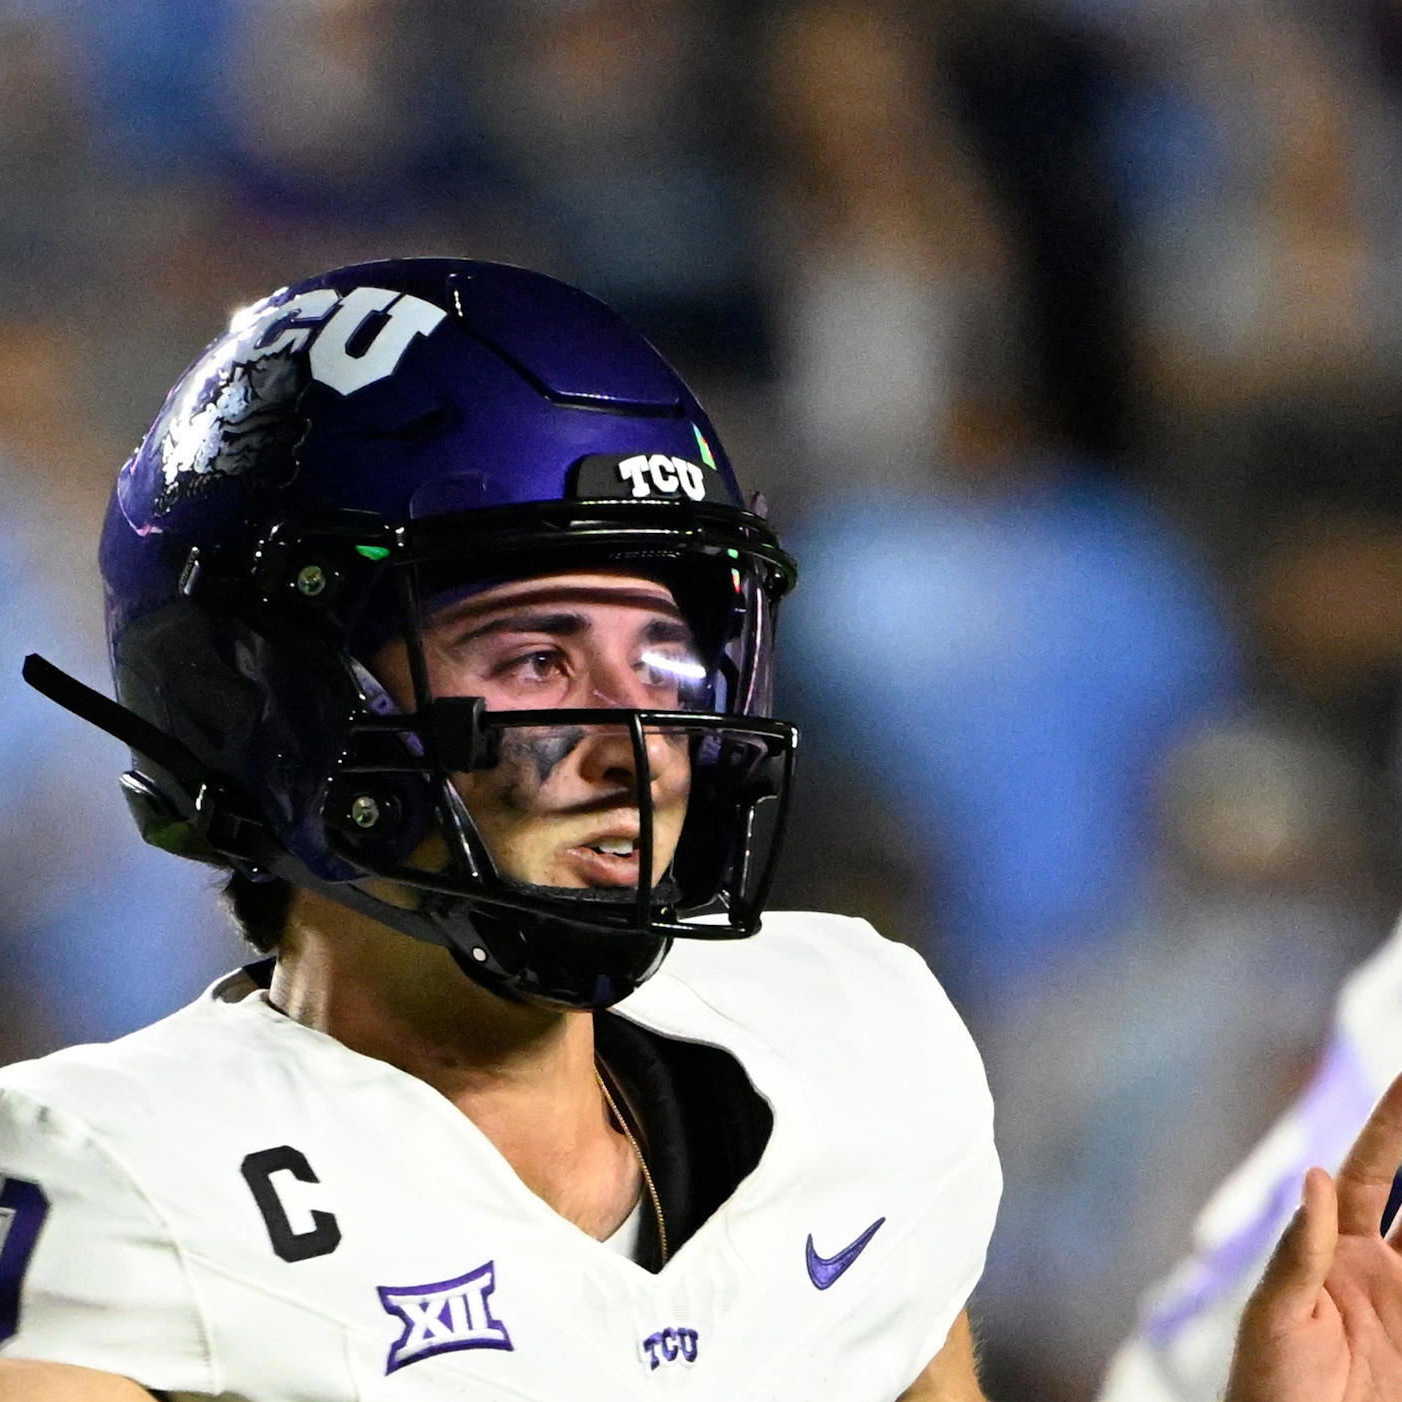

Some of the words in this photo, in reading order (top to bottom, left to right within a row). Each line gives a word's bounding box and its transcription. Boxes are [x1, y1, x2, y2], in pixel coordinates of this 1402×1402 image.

[618, 454, 706, 502] TCU
[240, 1145, 343, 1263] C
[382, 1266, 509, 1366] XII
[643, 1327, 699, 1371] TCU
